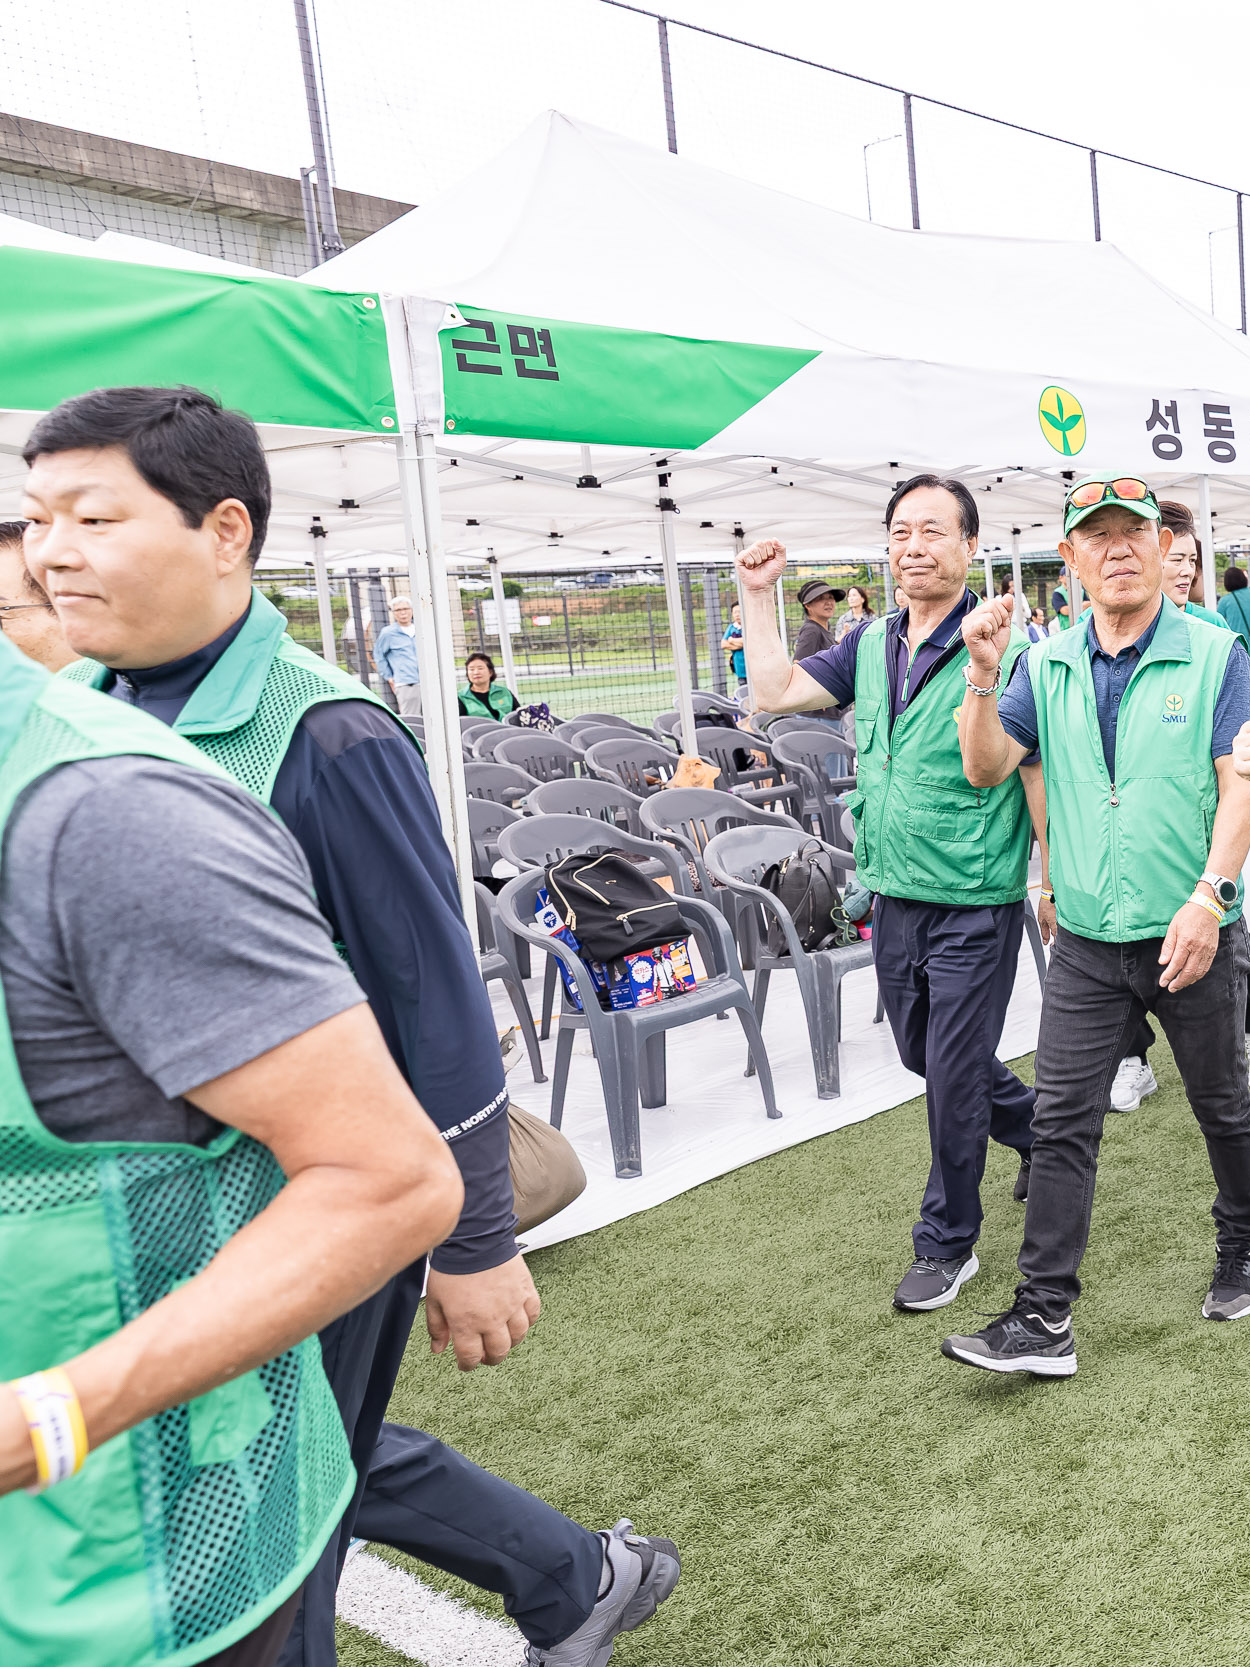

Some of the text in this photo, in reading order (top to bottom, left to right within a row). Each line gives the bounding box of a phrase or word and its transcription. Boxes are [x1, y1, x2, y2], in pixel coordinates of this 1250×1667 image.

[451, 317, 560, 381] 근면
[1161, 714, 1187, 723] SMU
[439, 1125, 462, 1140] THE
[460, 1101, 498, 1131] NORTH
